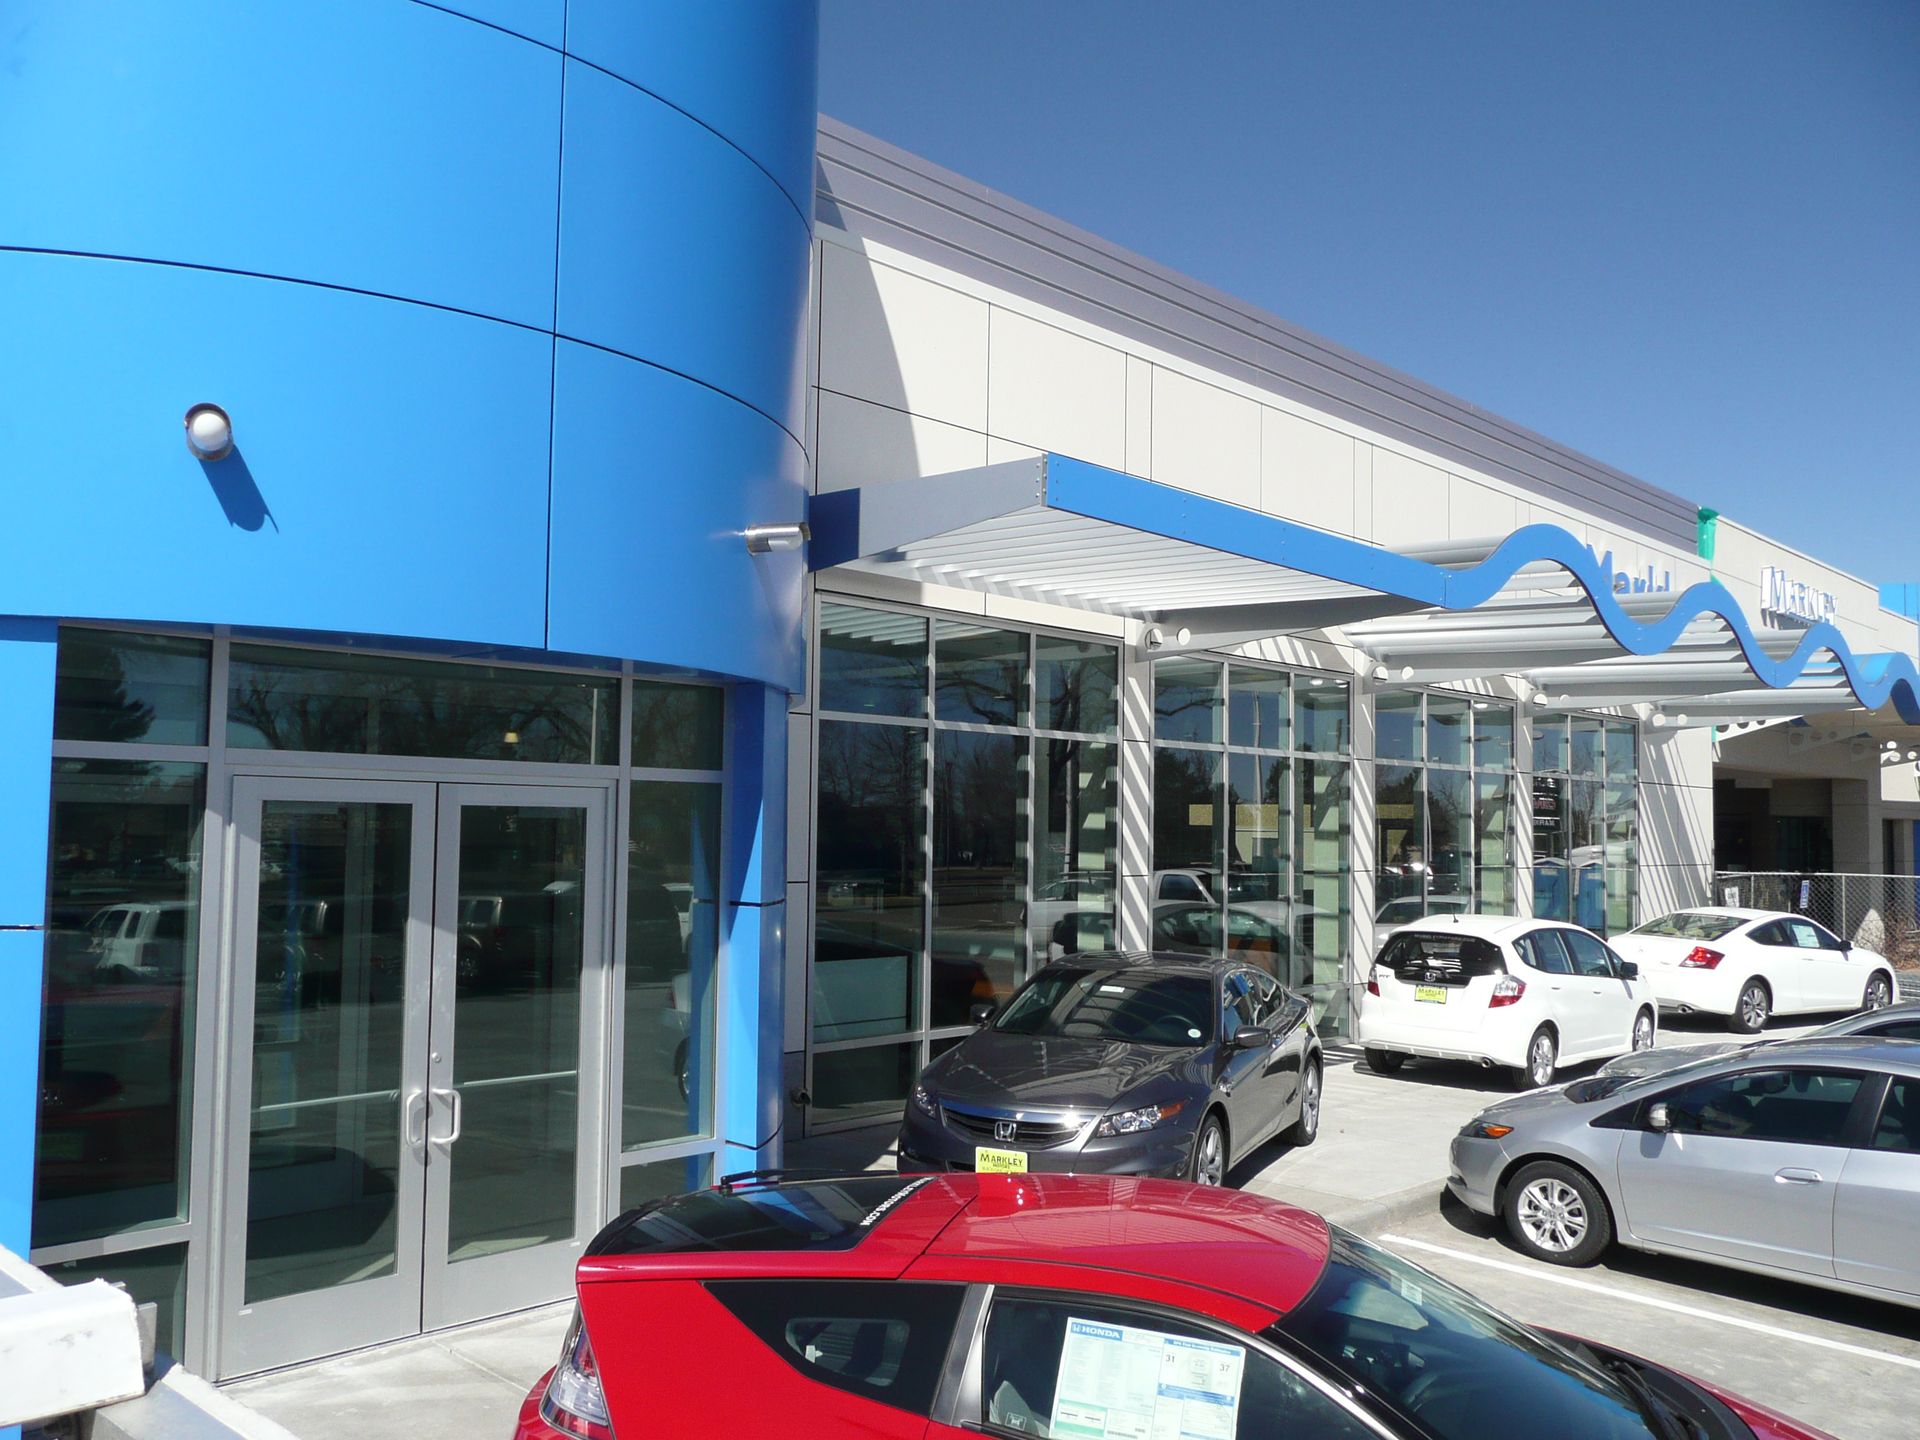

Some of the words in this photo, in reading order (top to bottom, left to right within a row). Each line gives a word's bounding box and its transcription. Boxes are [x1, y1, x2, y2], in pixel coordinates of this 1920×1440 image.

[980, 1153, 1024, 1167] MARKLEY
[1082, 1325, 1121, 1339] HONDA
[1165, 1354, 1175, 1364] 31
[1219, 1363, 1230, 1373] 37
